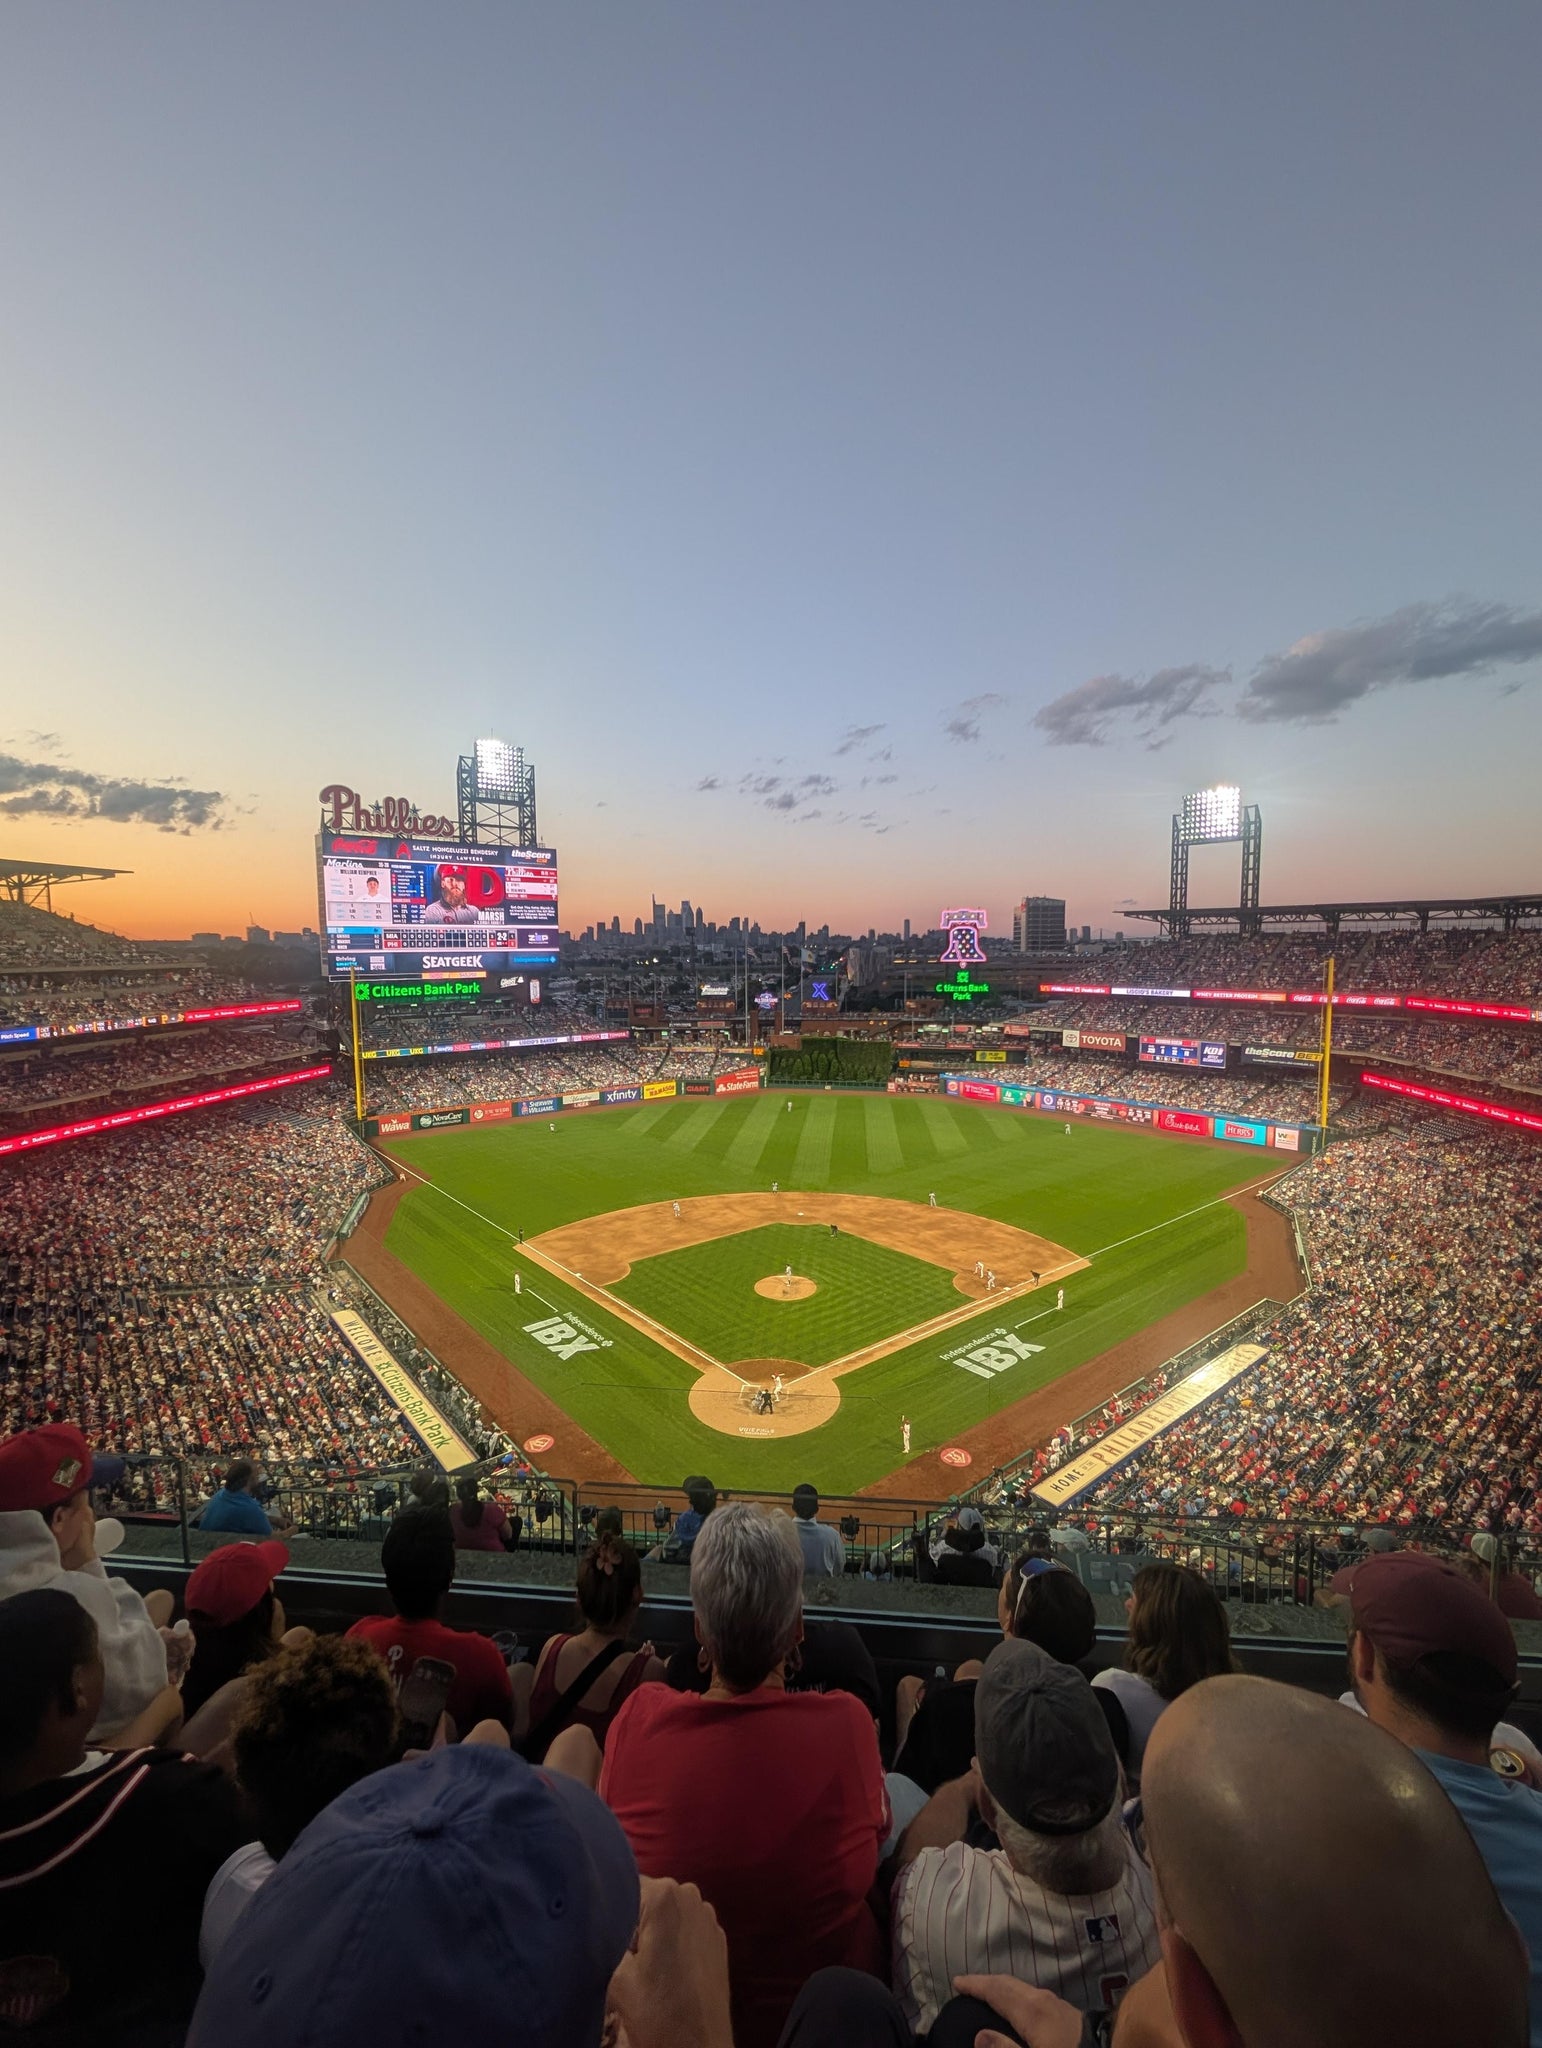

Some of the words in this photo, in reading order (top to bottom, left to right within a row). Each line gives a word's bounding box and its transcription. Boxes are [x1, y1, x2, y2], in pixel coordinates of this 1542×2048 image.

[319, 785, 455, 837] Phillies
[327, 858, 363, 868] Marlins
[478, 912, 504, 921] MARSH
[422, 955, 483, 968] SEATGEEK
[372, 985, 422, 997] Citizens
[424, 983, 453, 994] Bank
[456, 982, 480, 993] Park
[812, 983, 828, 1000] X
[936, 984, 968, 992] Ctizens
[968, 984, 989, 992] Bank
[1081, 1035, 1122, 1047] TOYOTA
[1245, 1047, 1294, 1059] theScore
[607, 1089, 637, 1102] xfinity
[529, 1100, 553, 1108] SHERWIN
[432, 1113, 462, 1121] NovaCare
[381, 1122, 409, 1132] Wawa
[1227, 1126, 1251, 1137] HERR'S
[563, 1312, 604, 1341] Independence
[344, 1320, 382, 1357] WELCOME
[522, 1316, 600, 1360] IBX
[939, 1332, 996, 1360] Independence
[953, 1333, 1046, 1378] IBX
[381, 1368, 414, 1404] Citizens
[405, 1400, 433, 1426] Bank
[424, 1423, 453, 1449] Park
[1050, 1468, 1084, 1493] HOME
